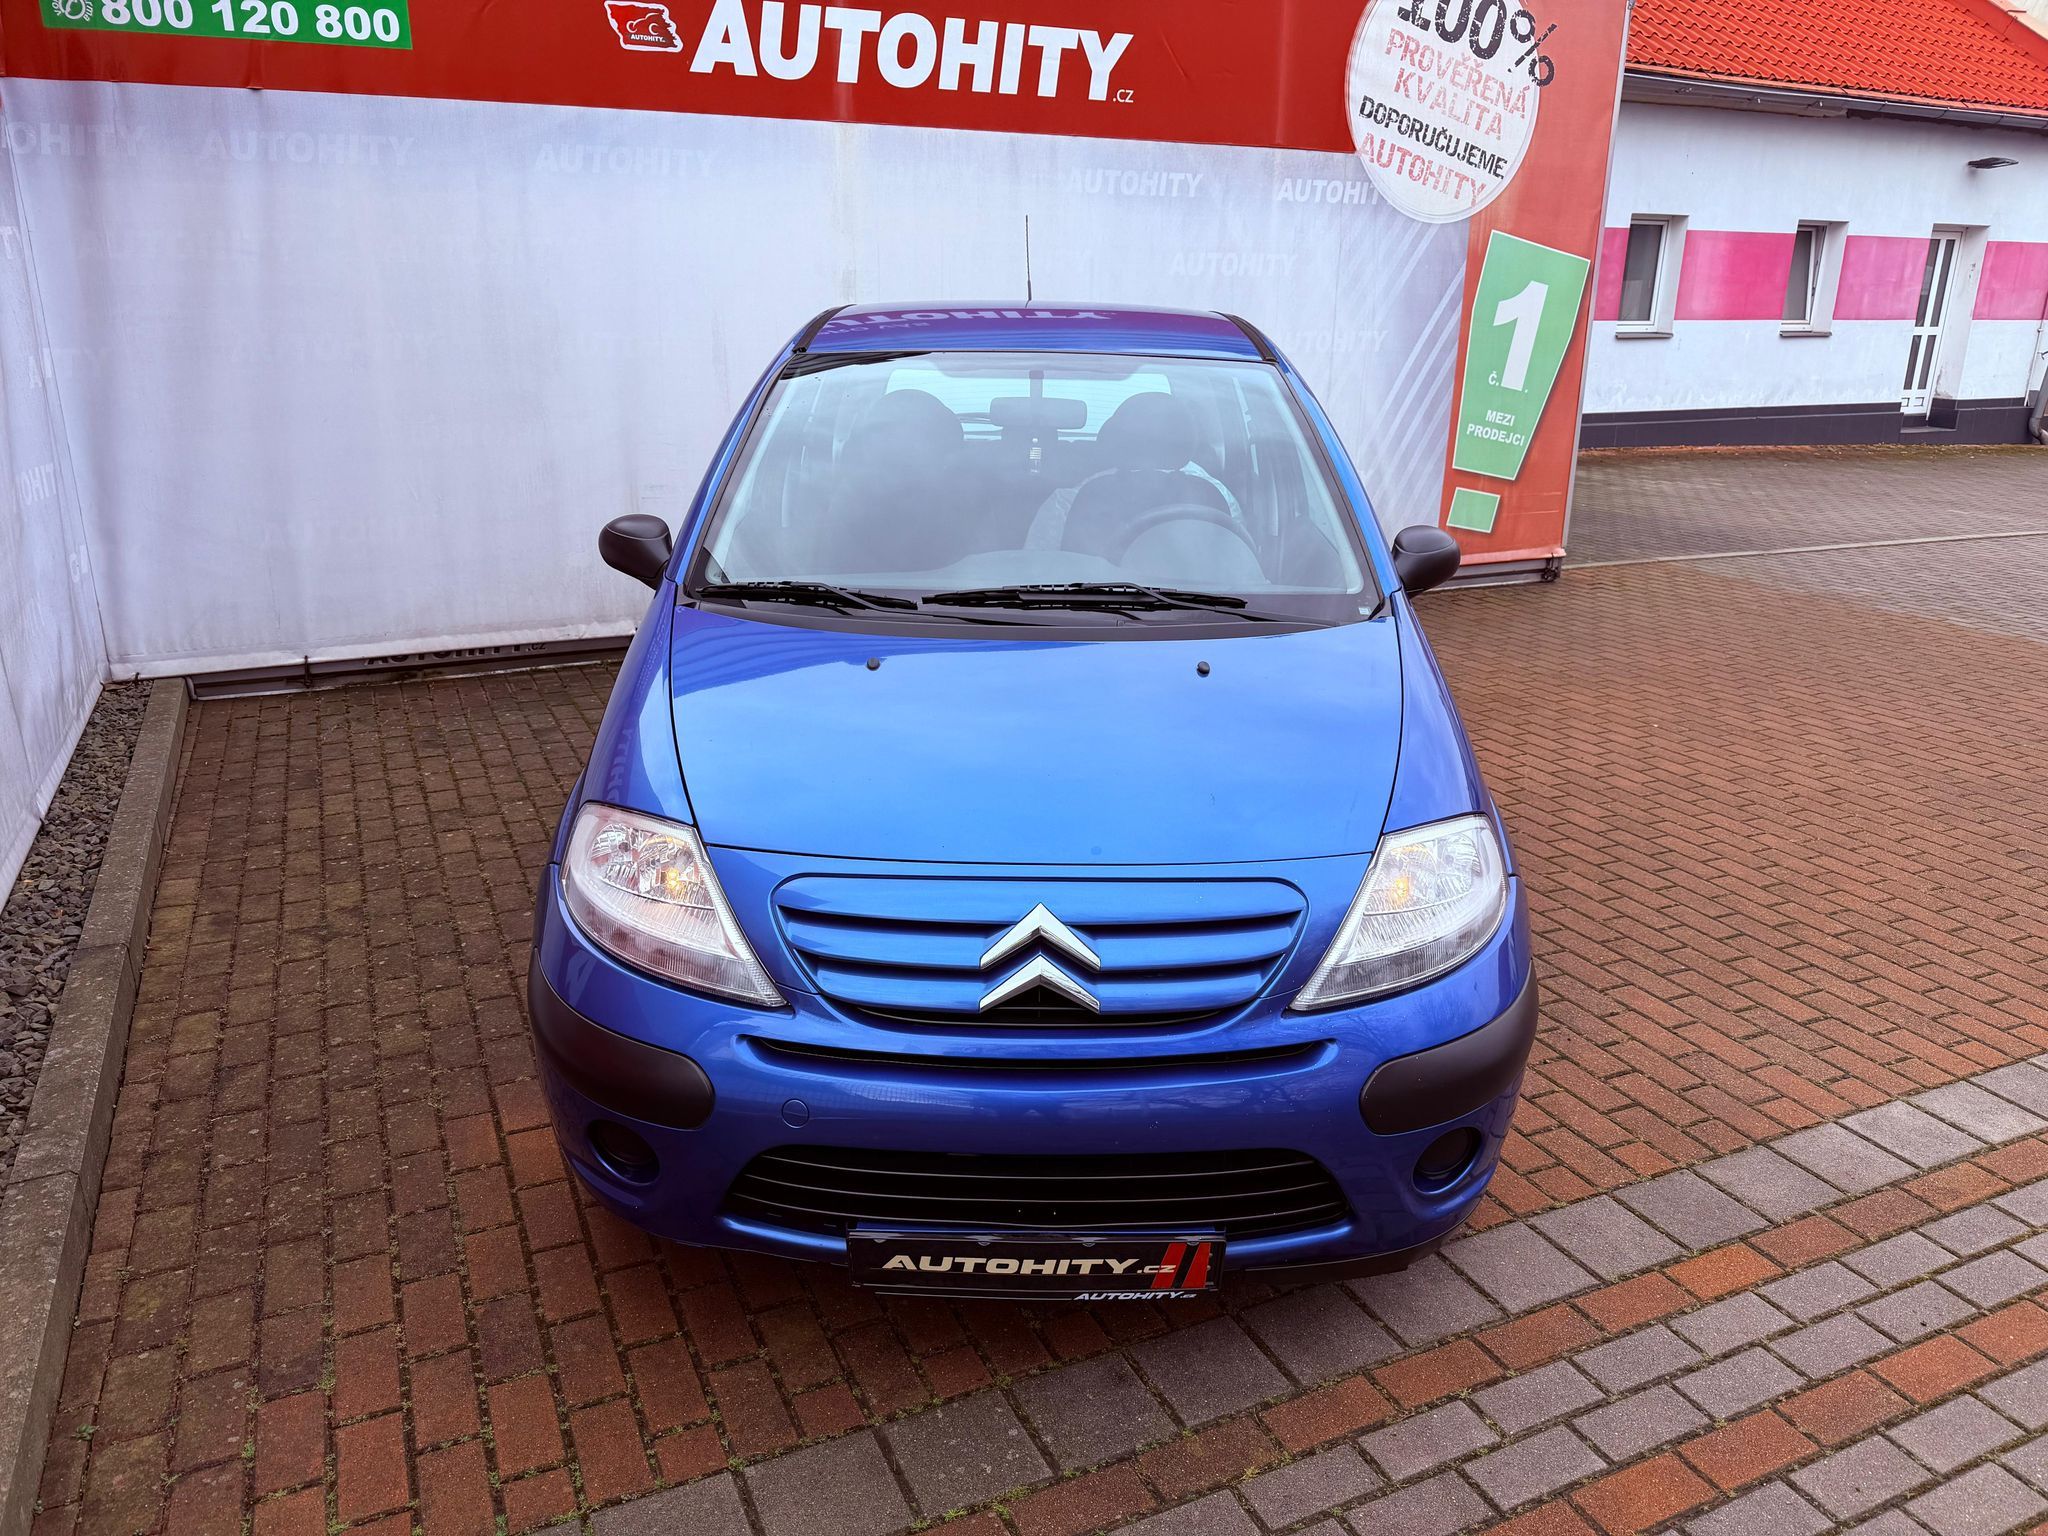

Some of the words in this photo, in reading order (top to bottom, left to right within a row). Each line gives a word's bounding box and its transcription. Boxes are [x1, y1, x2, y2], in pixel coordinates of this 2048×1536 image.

[102, 0, 193, 29] 800
[211, 0, 299, 36] 120
[315, 4, 400, 42] 800
[1385, 28, 1530, 119] PROVĚŘENÁ
[1393, 68, 1502, 141] KVALITA
[199, 130, 416, 166] AUTOHITY
[1358, 95, 1508, 180] DOPORUČUJEME
[533, 143, 720, 178] AUTOHITY
[1357, 132, 1487, 207] AUTOHITY
[1066, 166, 1204, 198] AUTOHITY
[1276, 178, 1390, 206] AUTOHIT
[1168, 252, 1299, 277] AUTOHITY
[1275, 328, 1387, 352] UTOHITY
[1466, 423, 1526, 447] PRODEJCI
[1485, 409, 1516, 427] MEZI
